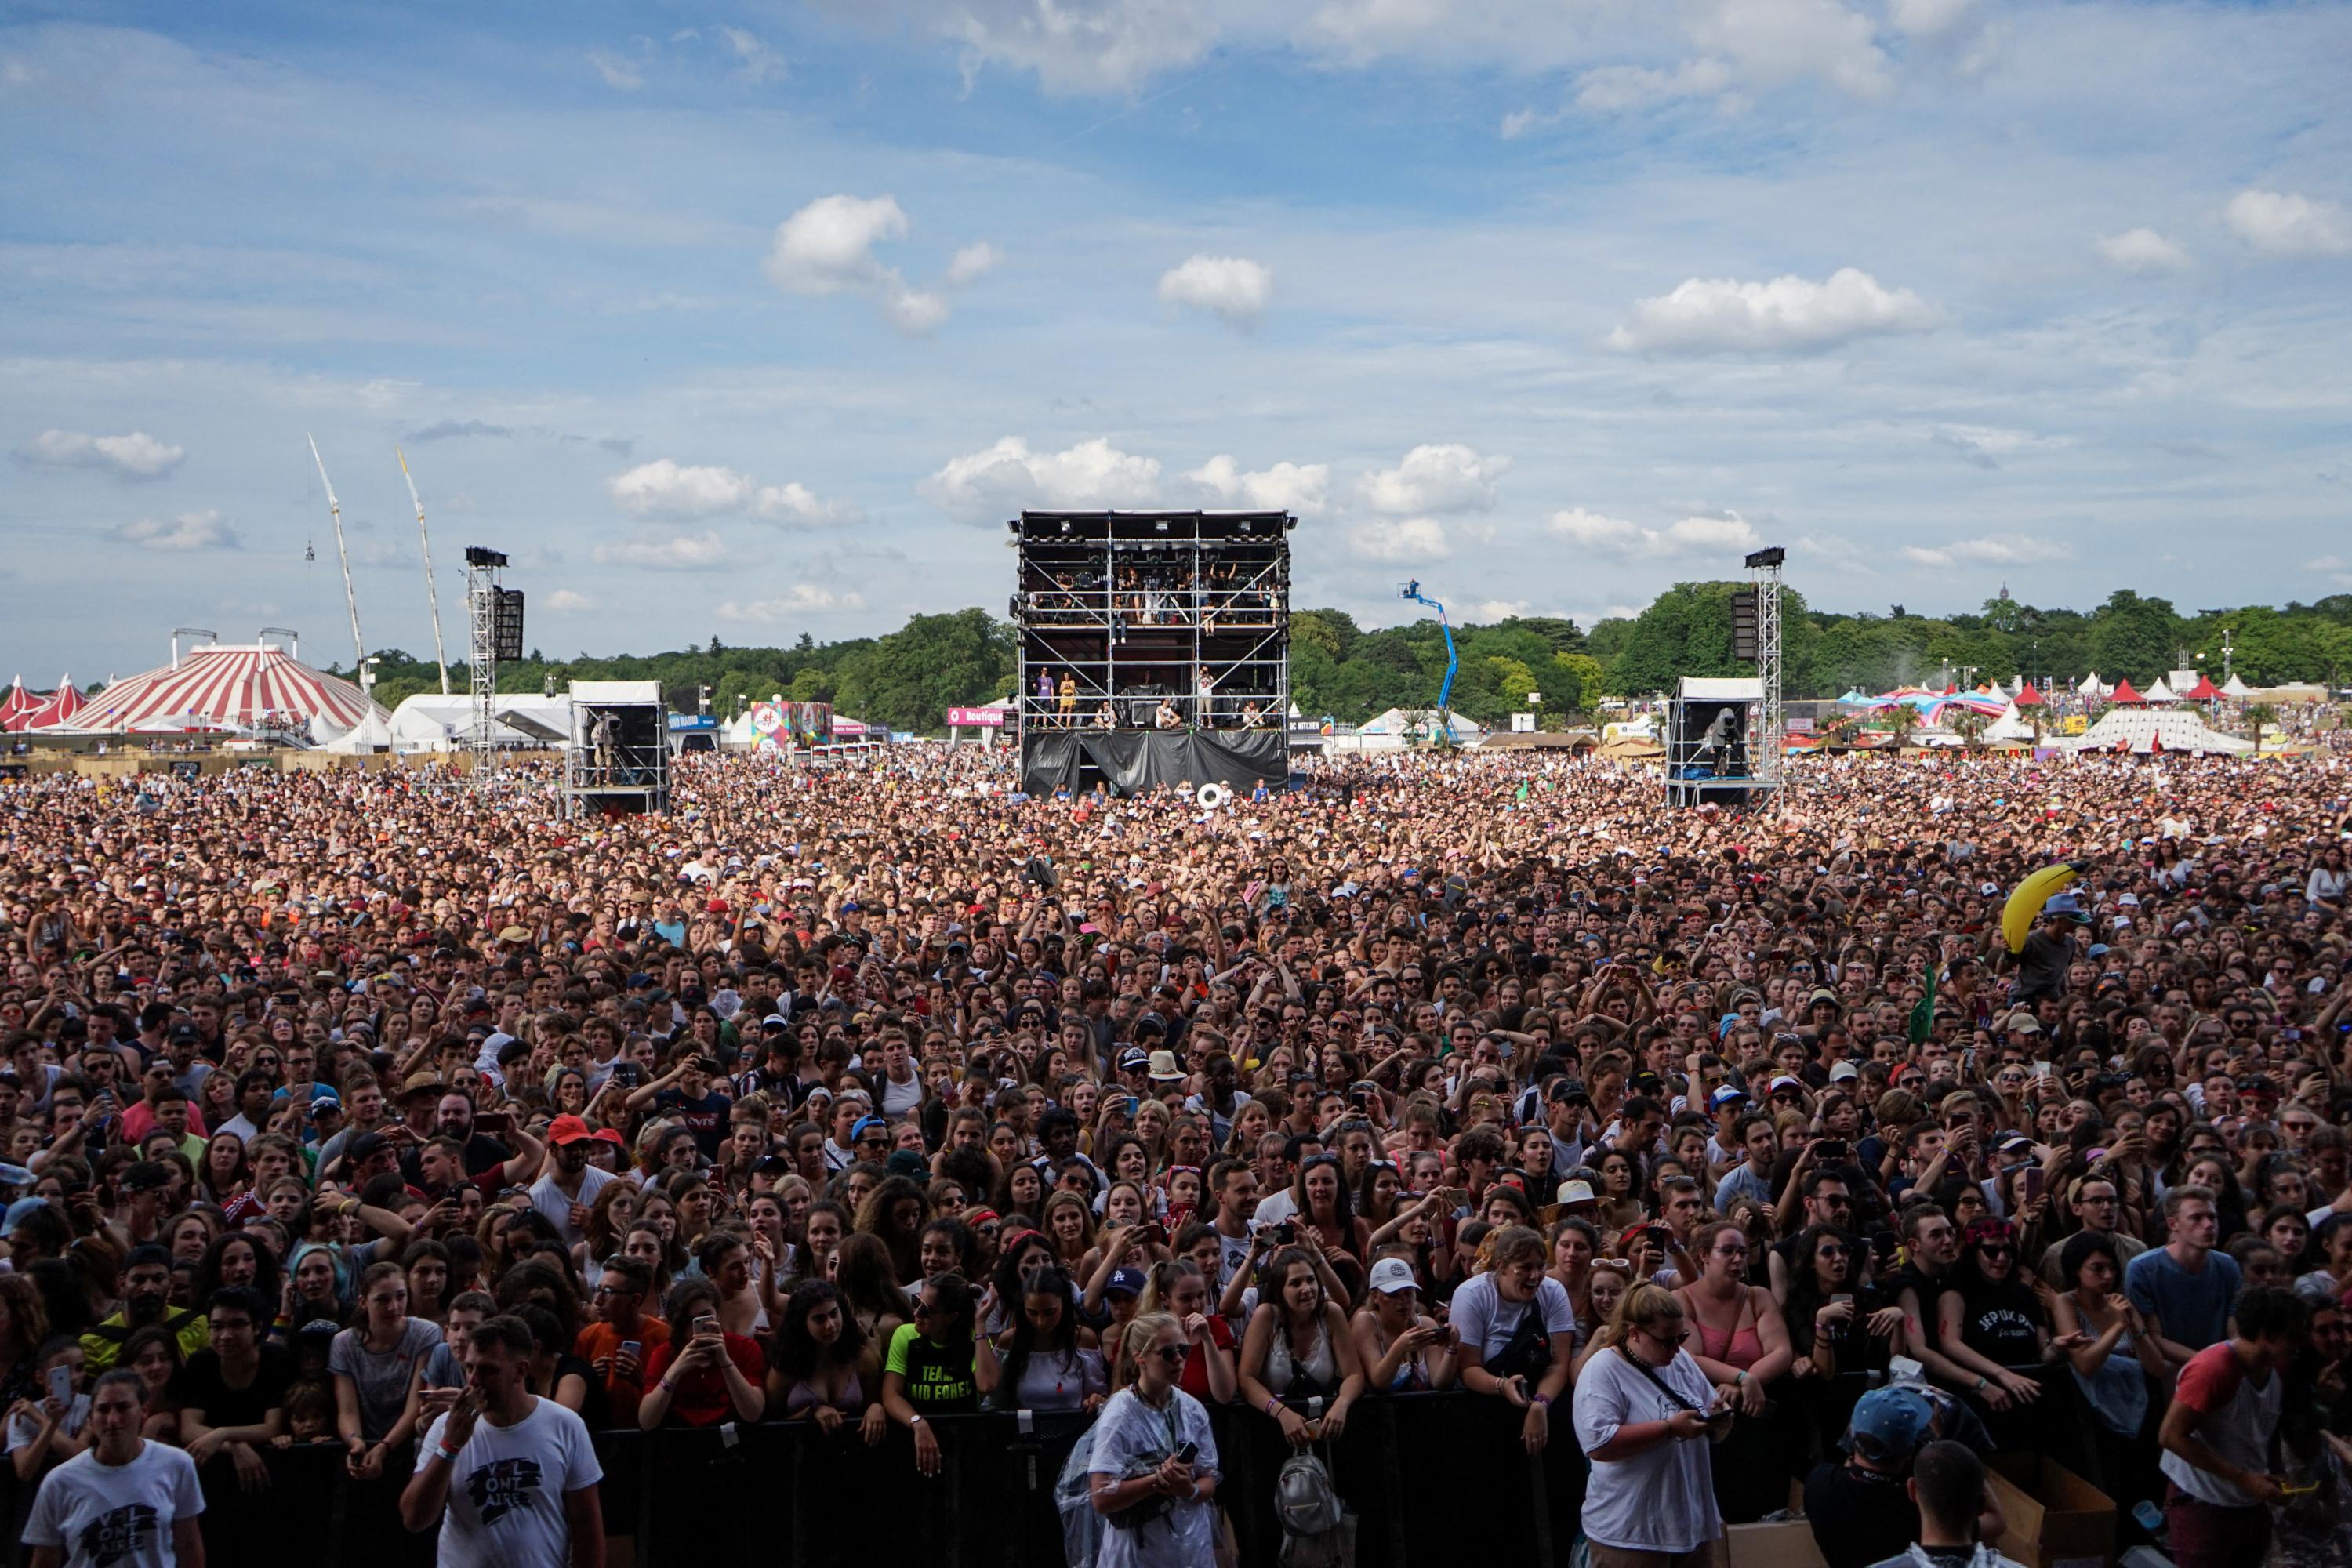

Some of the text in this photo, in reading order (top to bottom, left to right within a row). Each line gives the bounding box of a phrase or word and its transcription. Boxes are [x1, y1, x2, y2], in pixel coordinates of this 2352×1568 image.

[681, 714, 698, 726] RADIO
[966, 710, 1004, 724] Boutique
[1298, 721, 1319, 730] KITCHEN
[908, 1382, 931, 1401] AID
[485, 1475, 523, 1493] ONT
